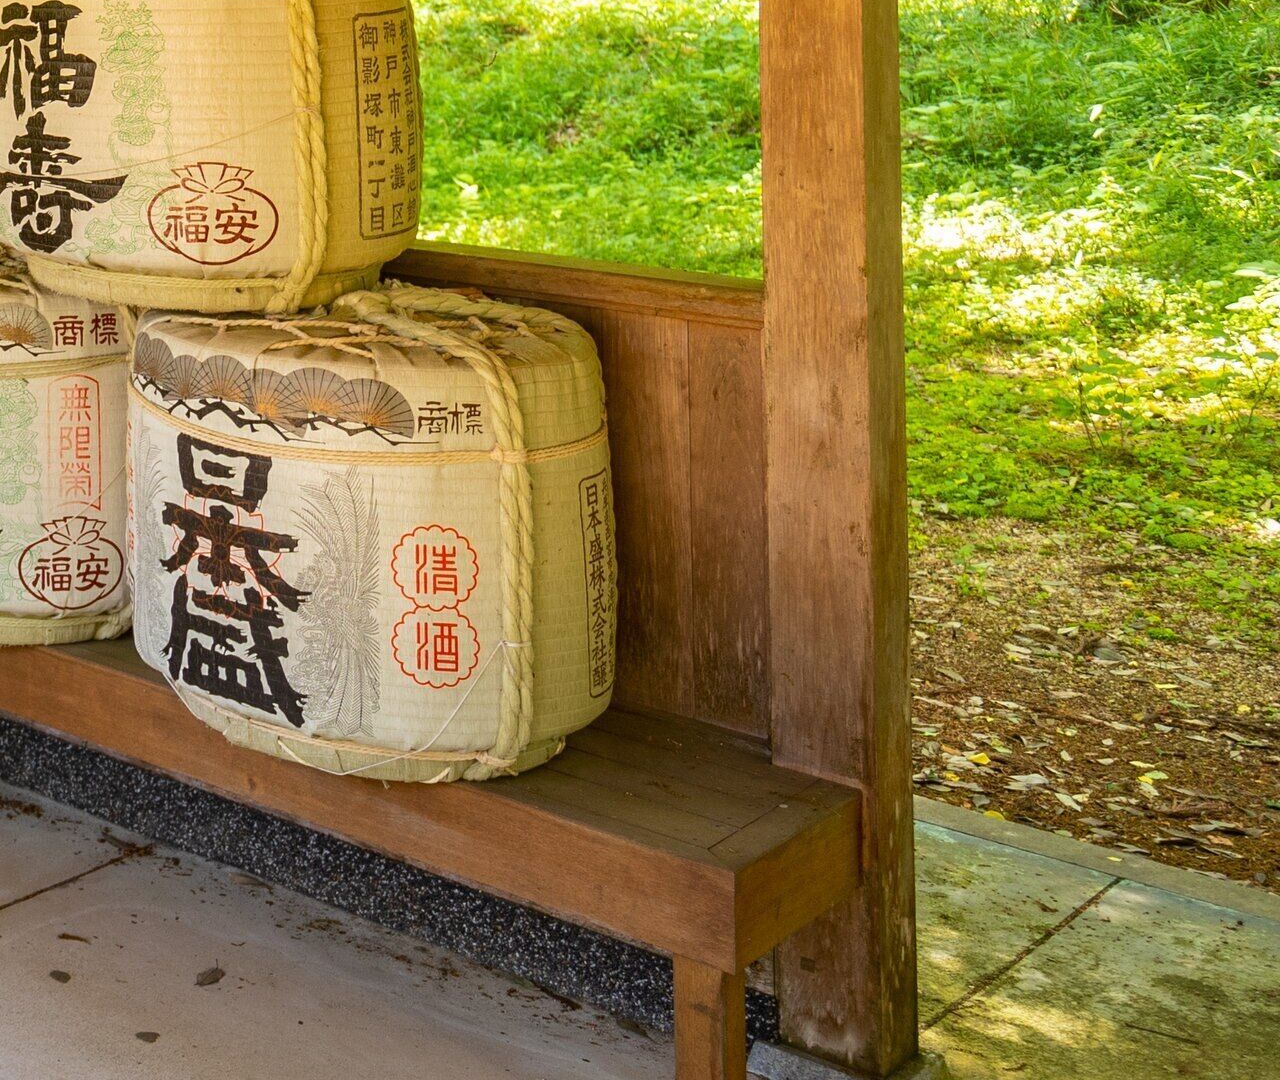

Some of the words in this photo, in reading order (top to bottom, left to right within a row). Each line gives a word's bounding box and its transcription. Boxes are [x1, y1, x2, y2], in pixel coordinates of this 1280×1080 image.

[383, 20, 406, 229] 神戸市東灘区
[52, 312, 120, 349] 商標
[416, 400, 485, 438] 商標
[159, 432, 313, 730] 日本盛
[414, 541, 460, 676] 清酒
